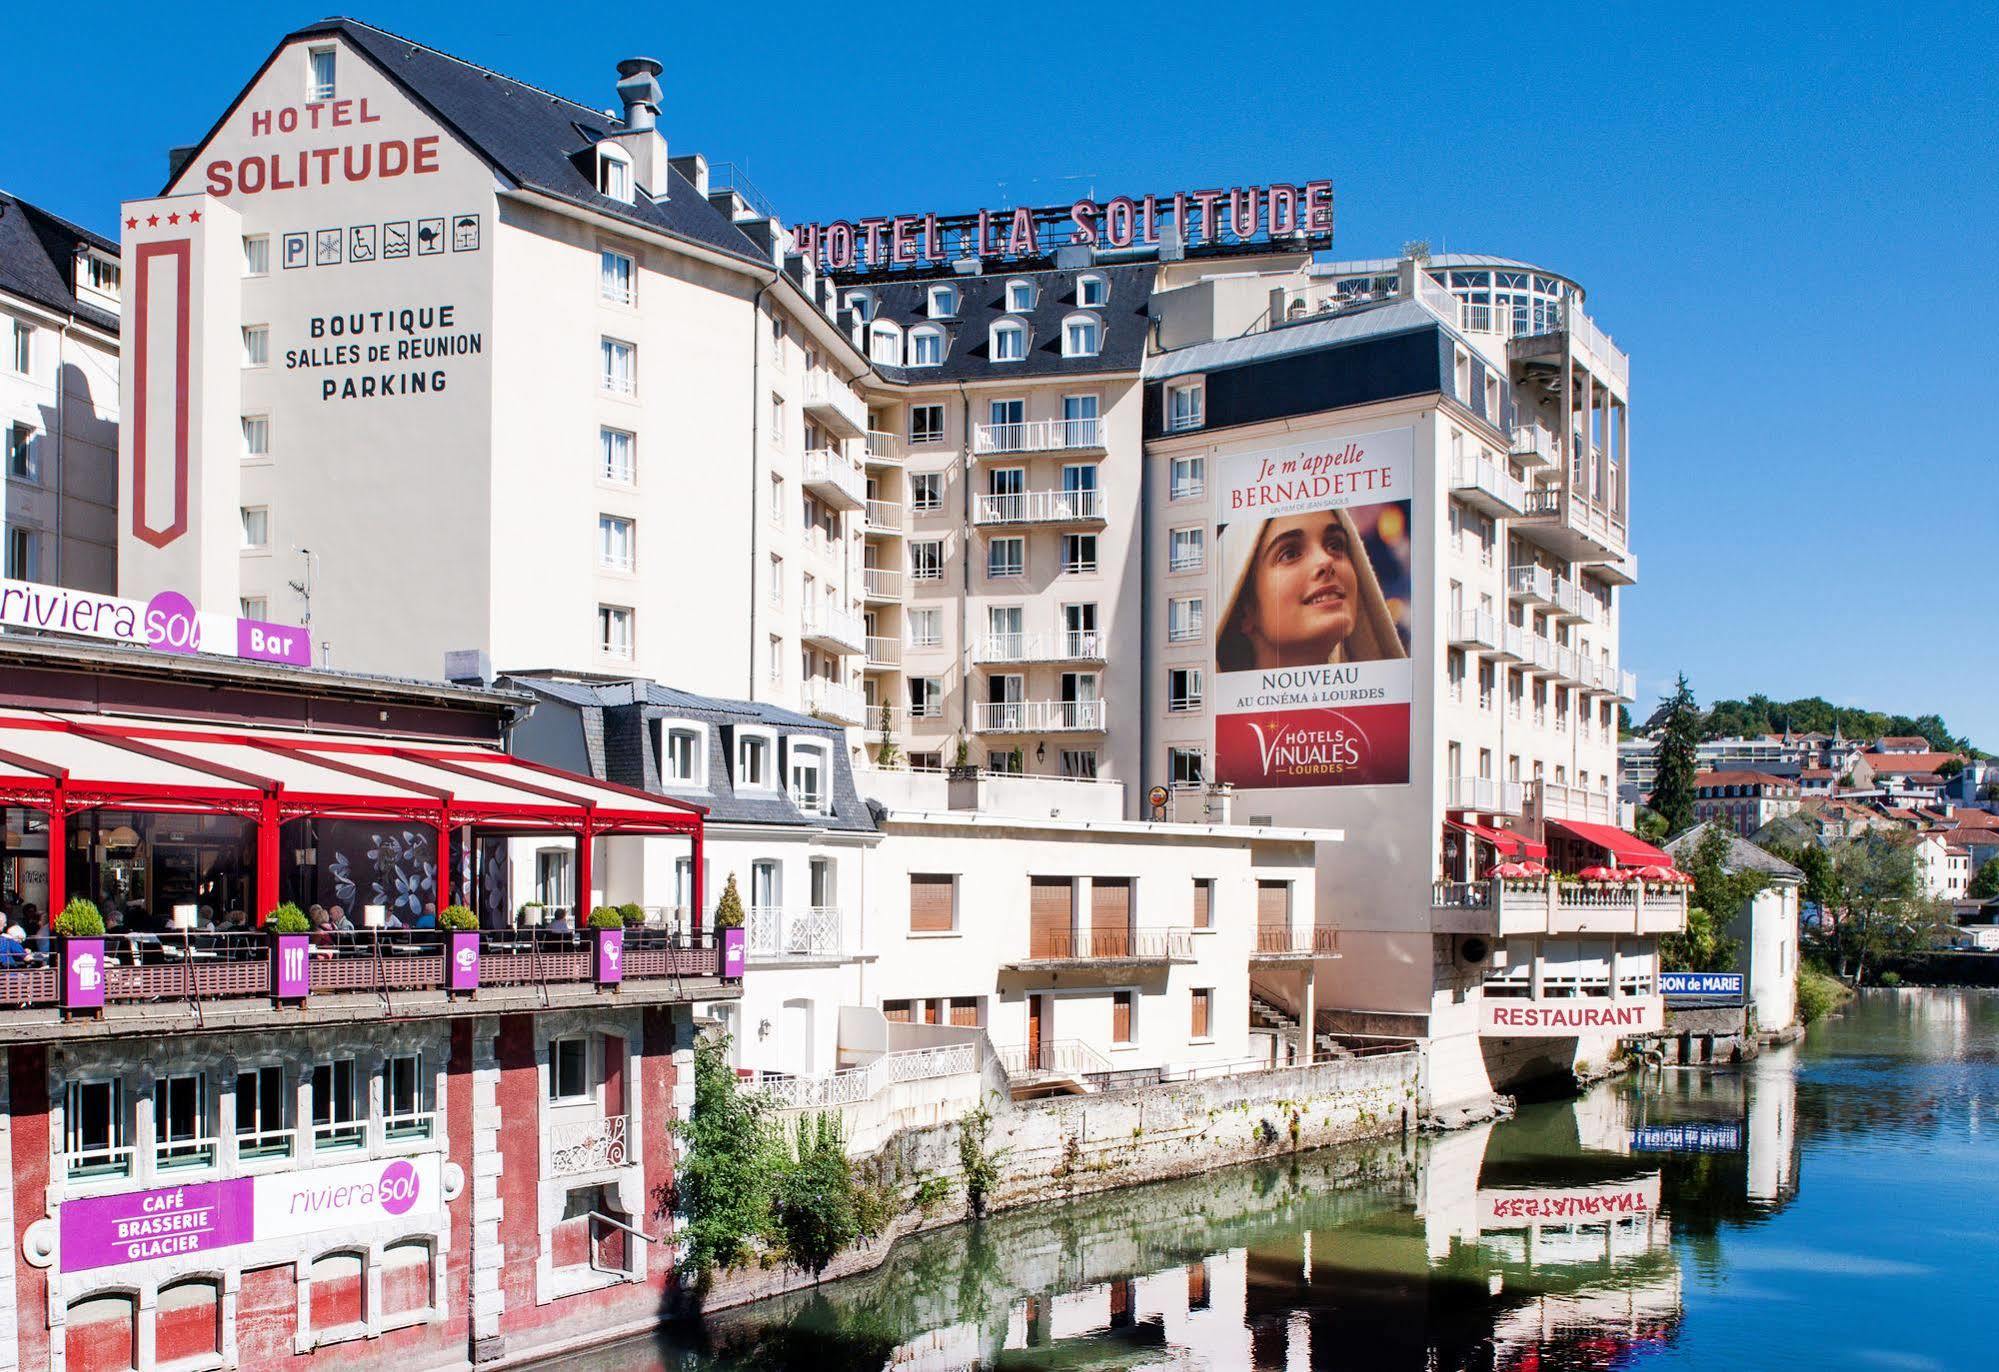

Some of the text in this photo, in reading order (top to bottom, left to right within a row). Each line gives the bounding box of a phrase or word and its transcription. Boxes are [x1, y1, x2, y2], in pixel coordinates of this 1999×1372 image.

[252, 98, 381, 137] HOTEL
[206, 135, 440, 197] SOLITUDE
[792, 179, 1333, 268] HOTEL LA SOLITUDE
[310, 306, 455, 338] BOUTIQUE
[286, 333, 482, 369] SALLES DE REUNION
[322, 370, 447, 401] PARKING
[1257, 444, 1365, 482] Je m'appelle
[1232, 467, 1393, 509] BERNADETTE
[0, 587, 136, 638] riviera
[251, 627, 293, 656] Bar
[1262, 667, 1359, 690] NOUVEAU
[1237, 697, 1254, 707] AU
[1257, 692, 1308, 706] CINÉMA
[1322, 688, 1385, 702] LOURDES
[1285, 729, 1344, 745] HÔTELS
[1288, 764, 1344, 775] LOURDES
[1687, 976, 1701, 991] de
[1702, 976, 1740, 991] MARIE
[1493, 1007, 1646, 1026] RESTAURANT
[143, 1187, 184, 1212] CAFÉ
[289, 1166, 417, 1214] riviera sol
[118, 1212, 208, 1238] BRASSERIE
[128, 1235, 199, 1259] GLACIER
